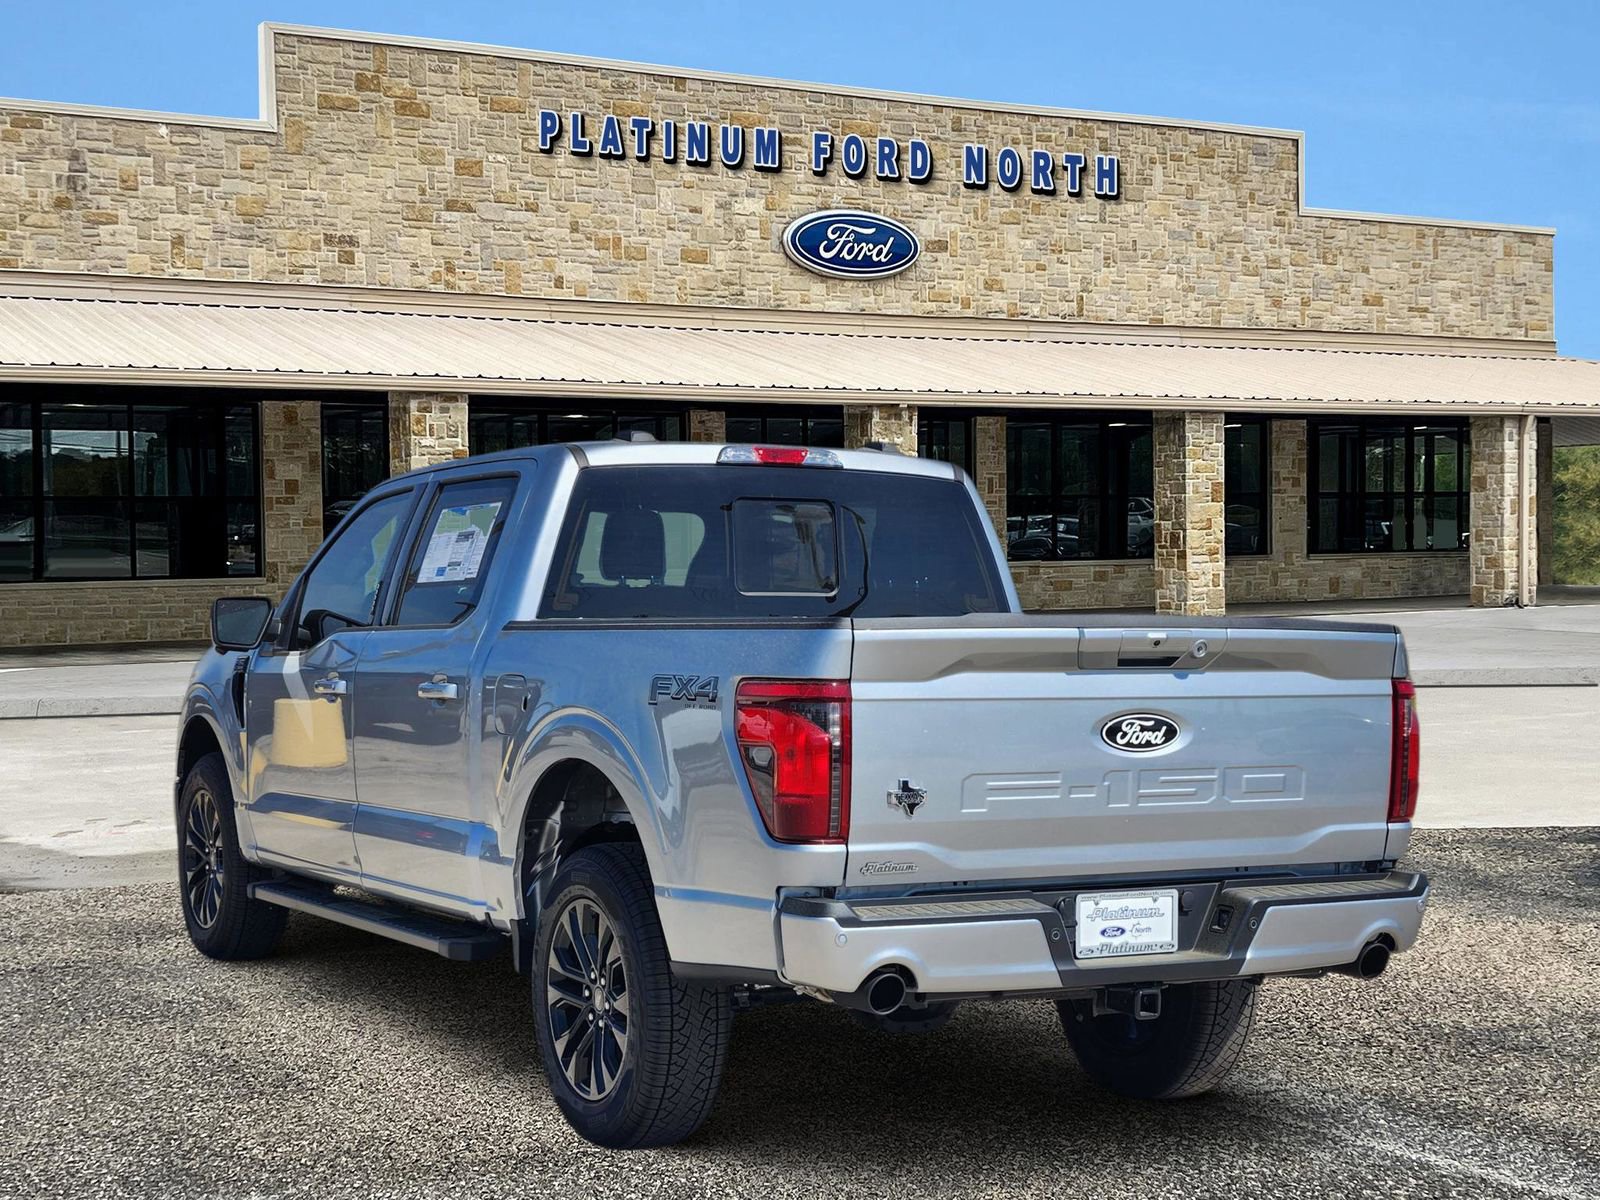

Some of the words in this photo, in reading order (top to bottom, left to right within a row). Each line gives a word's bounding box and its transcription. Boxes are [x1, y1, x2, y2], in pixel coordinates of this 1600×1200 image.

[538, 109, 782, 171] PLATINUM
[812, 131, 932, 184] FORD
[962, 143, 1120, 200] NORTH
[818, 221, 893, 264] Ford
[648, 673, 719, 705] FX4
[1116, 713, 1166, 746] Ford
[960, 764, 1305, 813] F-150
[860, 861, 919, 875] Platinum
[1086, 905, 1165, 922] Platinum
[1134, 926, 1152, 935] North
[1099, 942, 1155, 955] Platinum
